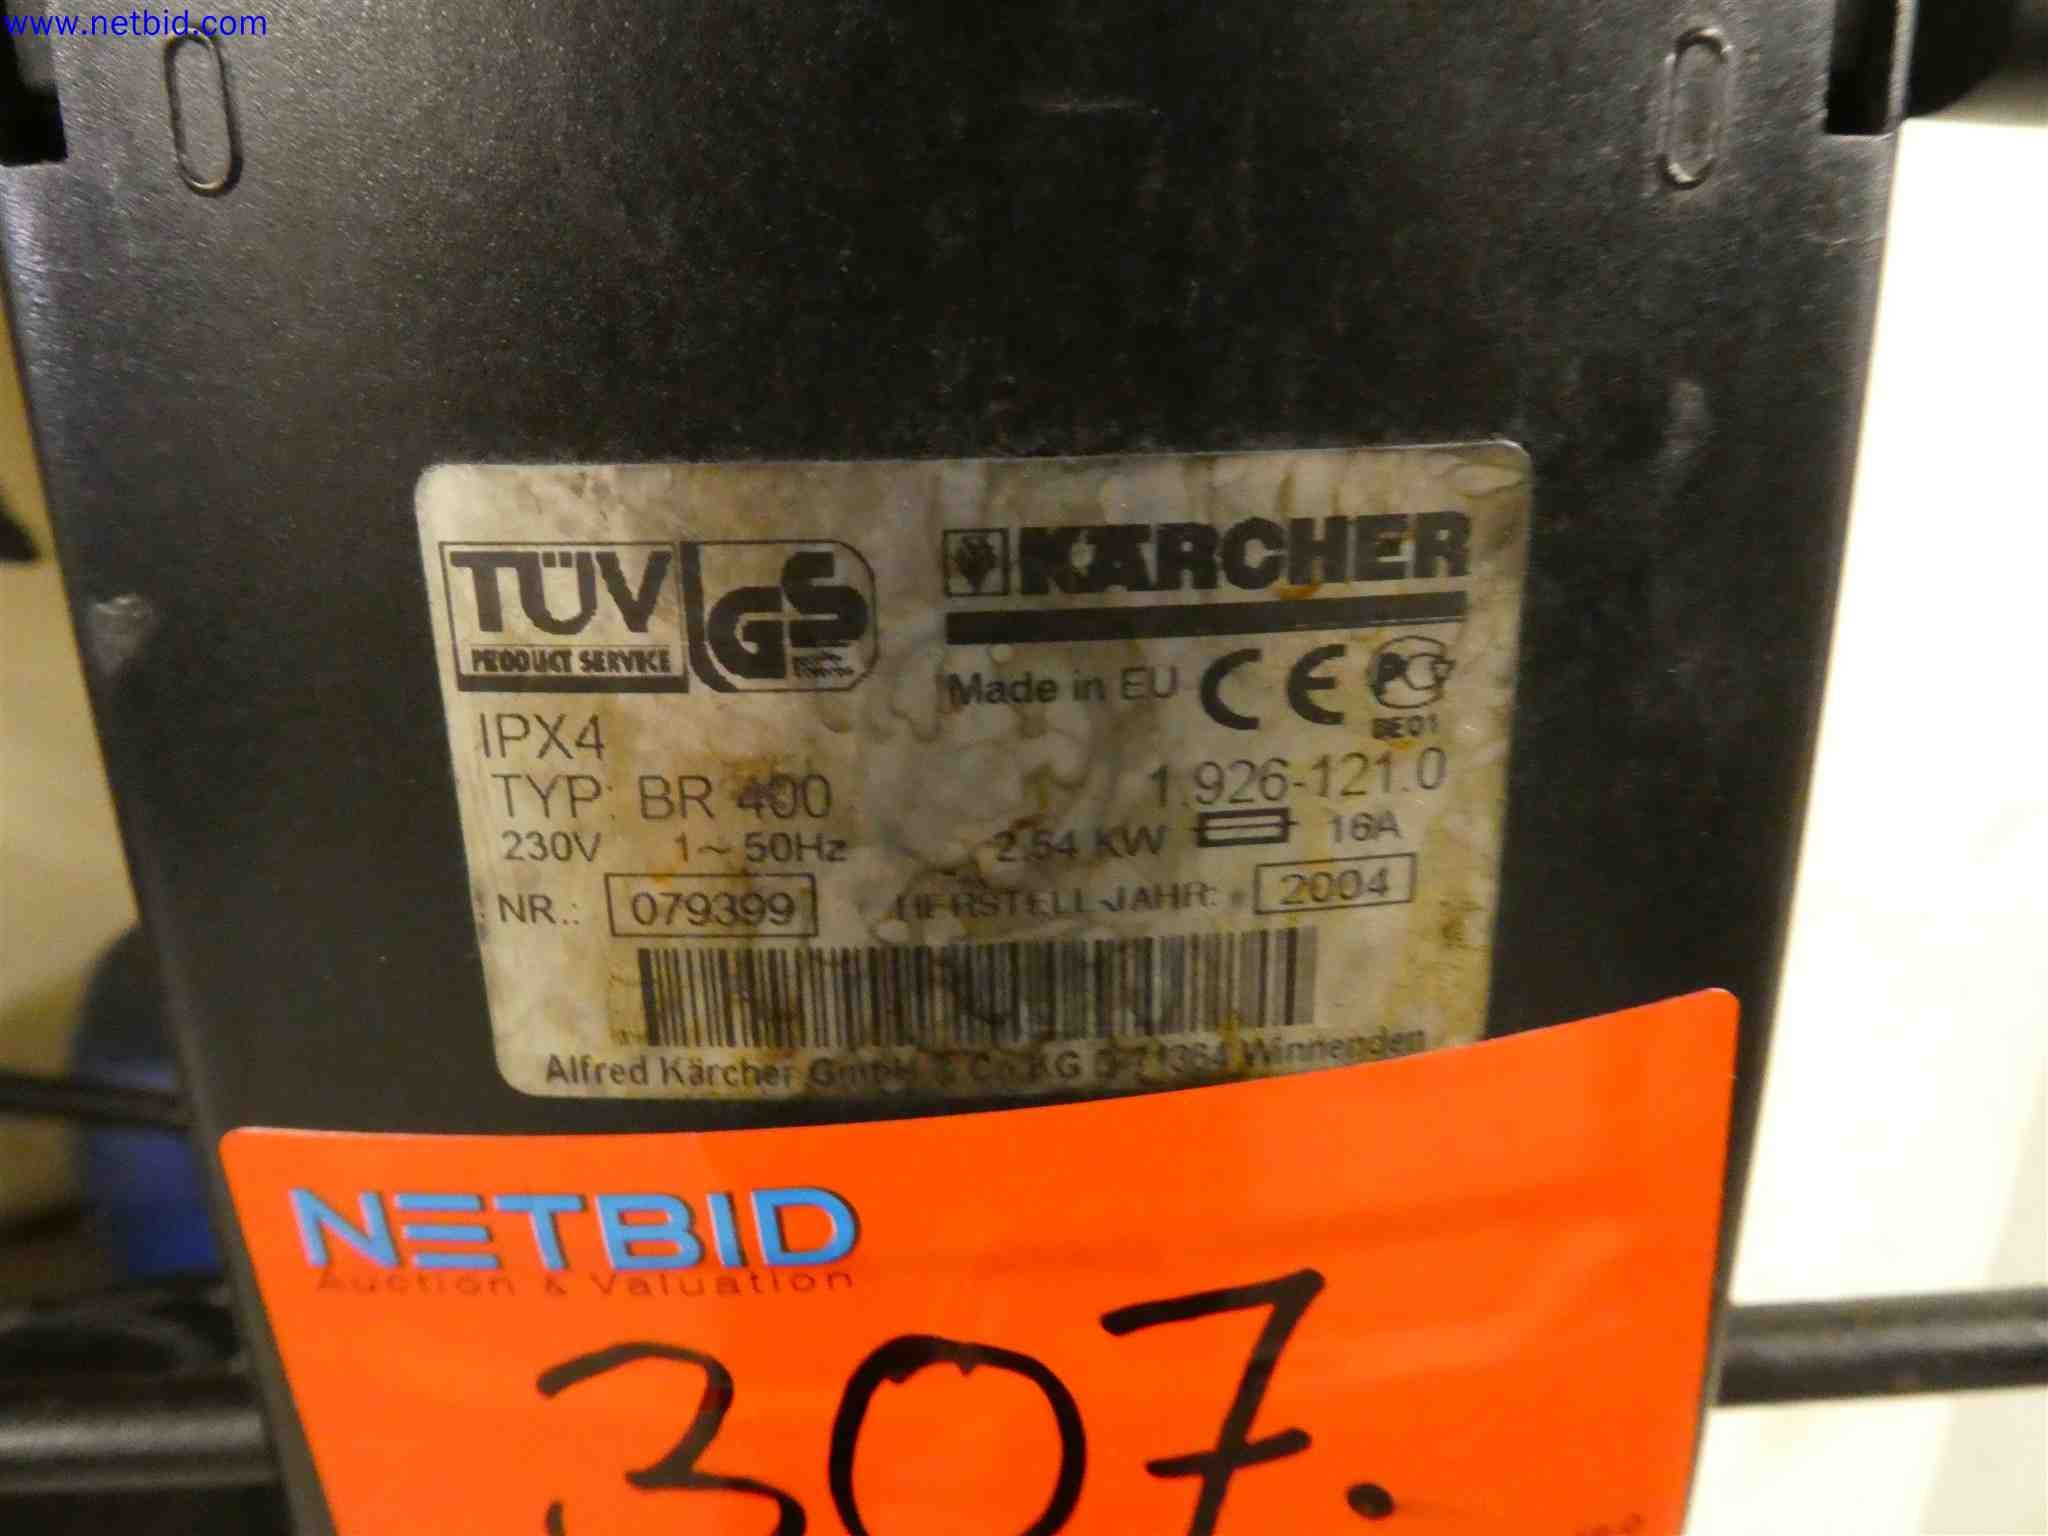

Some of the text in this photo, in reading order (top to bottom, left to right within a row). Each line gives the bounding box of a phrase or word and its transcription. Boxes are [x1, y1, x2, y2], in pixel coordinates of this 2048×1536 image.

[450, 551, 672, 636] TÜV
[472, 646, 672, 675] PRODUCT SERVICE
[947, 671, 1059, 705] Made
[1073, 669, 1105, 701] in
[1121, 665, 1179, 699] EU
[479, 712, 606, 760] IPX4
[492, 747, 1447, 822] TYP: BR 400 1.926-121.0
[502, 830, 600, 863] 230V
[744, 831, 847, 863] 50Hz
[1329, 812, 1402, 844] 16A
[631, 890, 796, 928] 079399
[1281, 867, 1392, 906] 2004
[545, 1053, 649, 1087] Alfred
[289, 1186, 862, 1272] NETBID
[317, 1270, 855, 1298] Auction & Valuation
